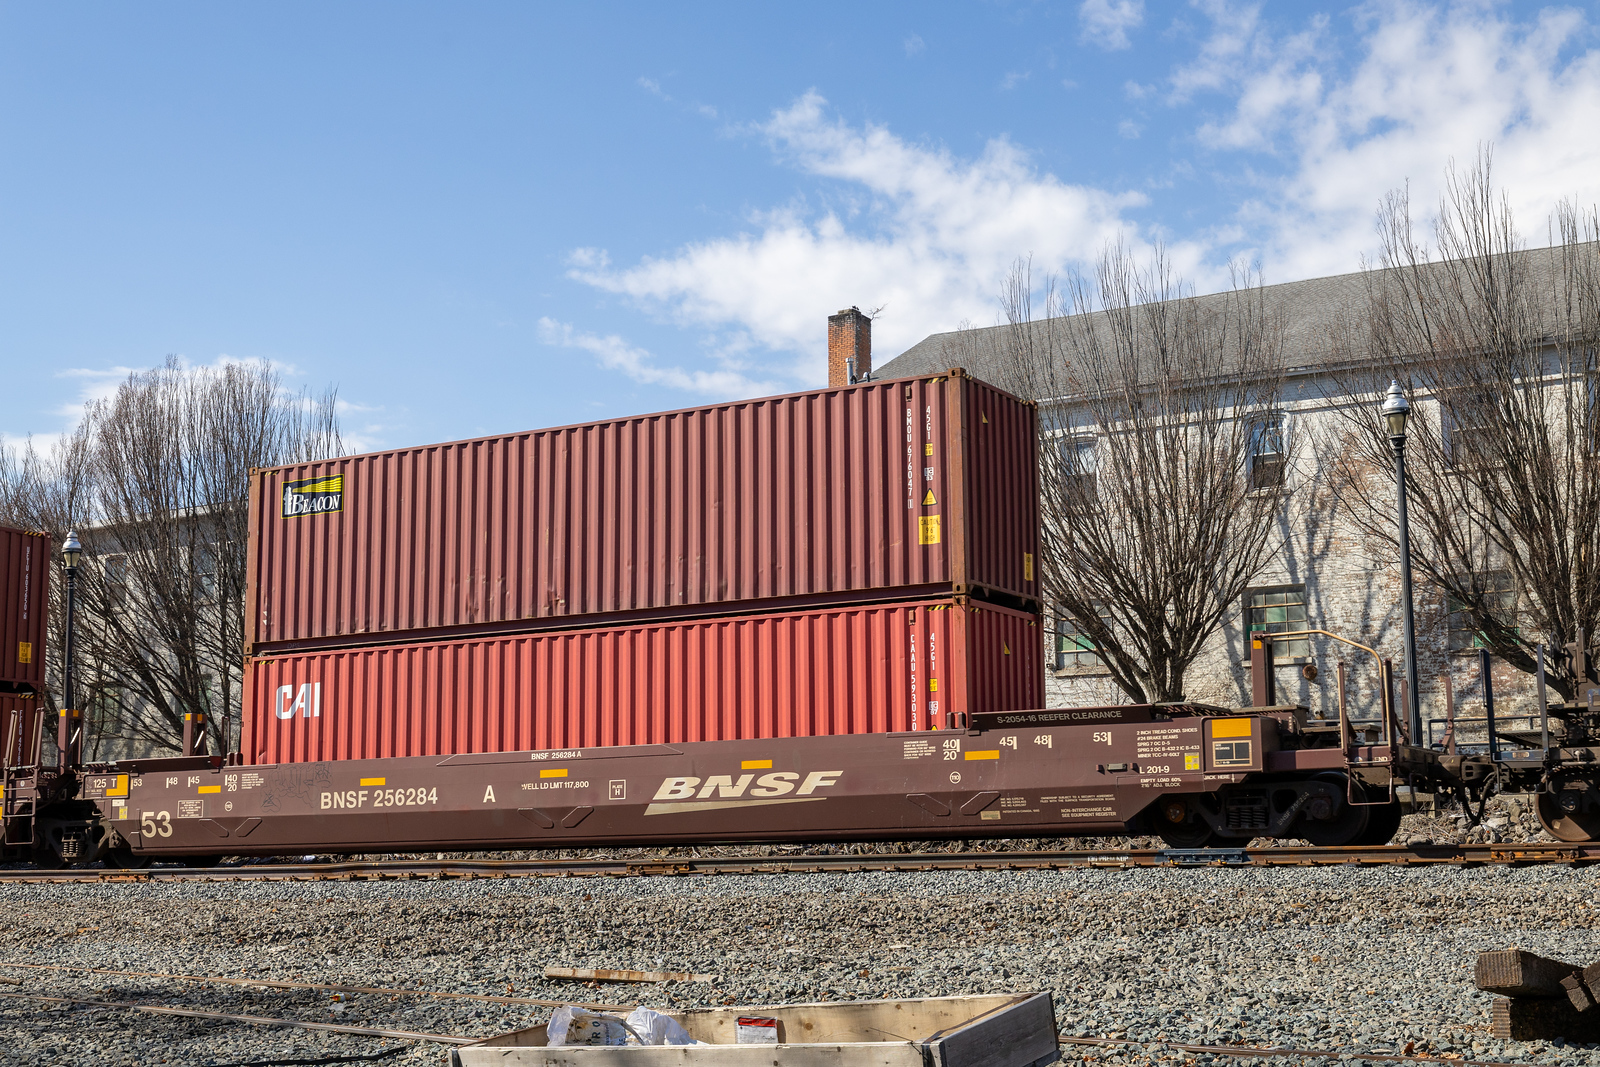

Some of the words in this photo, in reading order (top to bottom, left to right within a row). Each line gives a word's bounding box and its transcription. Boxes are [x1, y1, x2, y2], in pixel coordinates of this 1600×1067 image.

[292, 494, 342, 514] BEACON
[276, 682, 320, 720] CAI
[996, 714, 1036, 724] S-2054-16
[1038, 712, 1070, 722] REEFER
[1071, 710, 1122, 720] CLEARANCE
[999, 736, 1013, 746] 45
[1034, 735, 1048, 745] 48
[1093, 732, 1108, 742] 53
[943, 739, 957, 749] 40
[944, 751, 957, 760] 20
[1147, 766, 1170, 774] 201-9
[94, 778, 106, 788] 125
[111, 778, 116, 788] T
[168, 777, 178, 785] 48
[190, 776, 200, 784] 45
[228, 774, 238, 782] 40
[228, 784, 237, 792] 20
[564, 781, 589, 789] 117,800
[652, 770, 844, 800] BNSF
[320, 790, 368, 810] BNSF
[373, 787, 438, 807] 256284
[482, 785, 496, 803] A
[141, 810, 173, 838] 53
